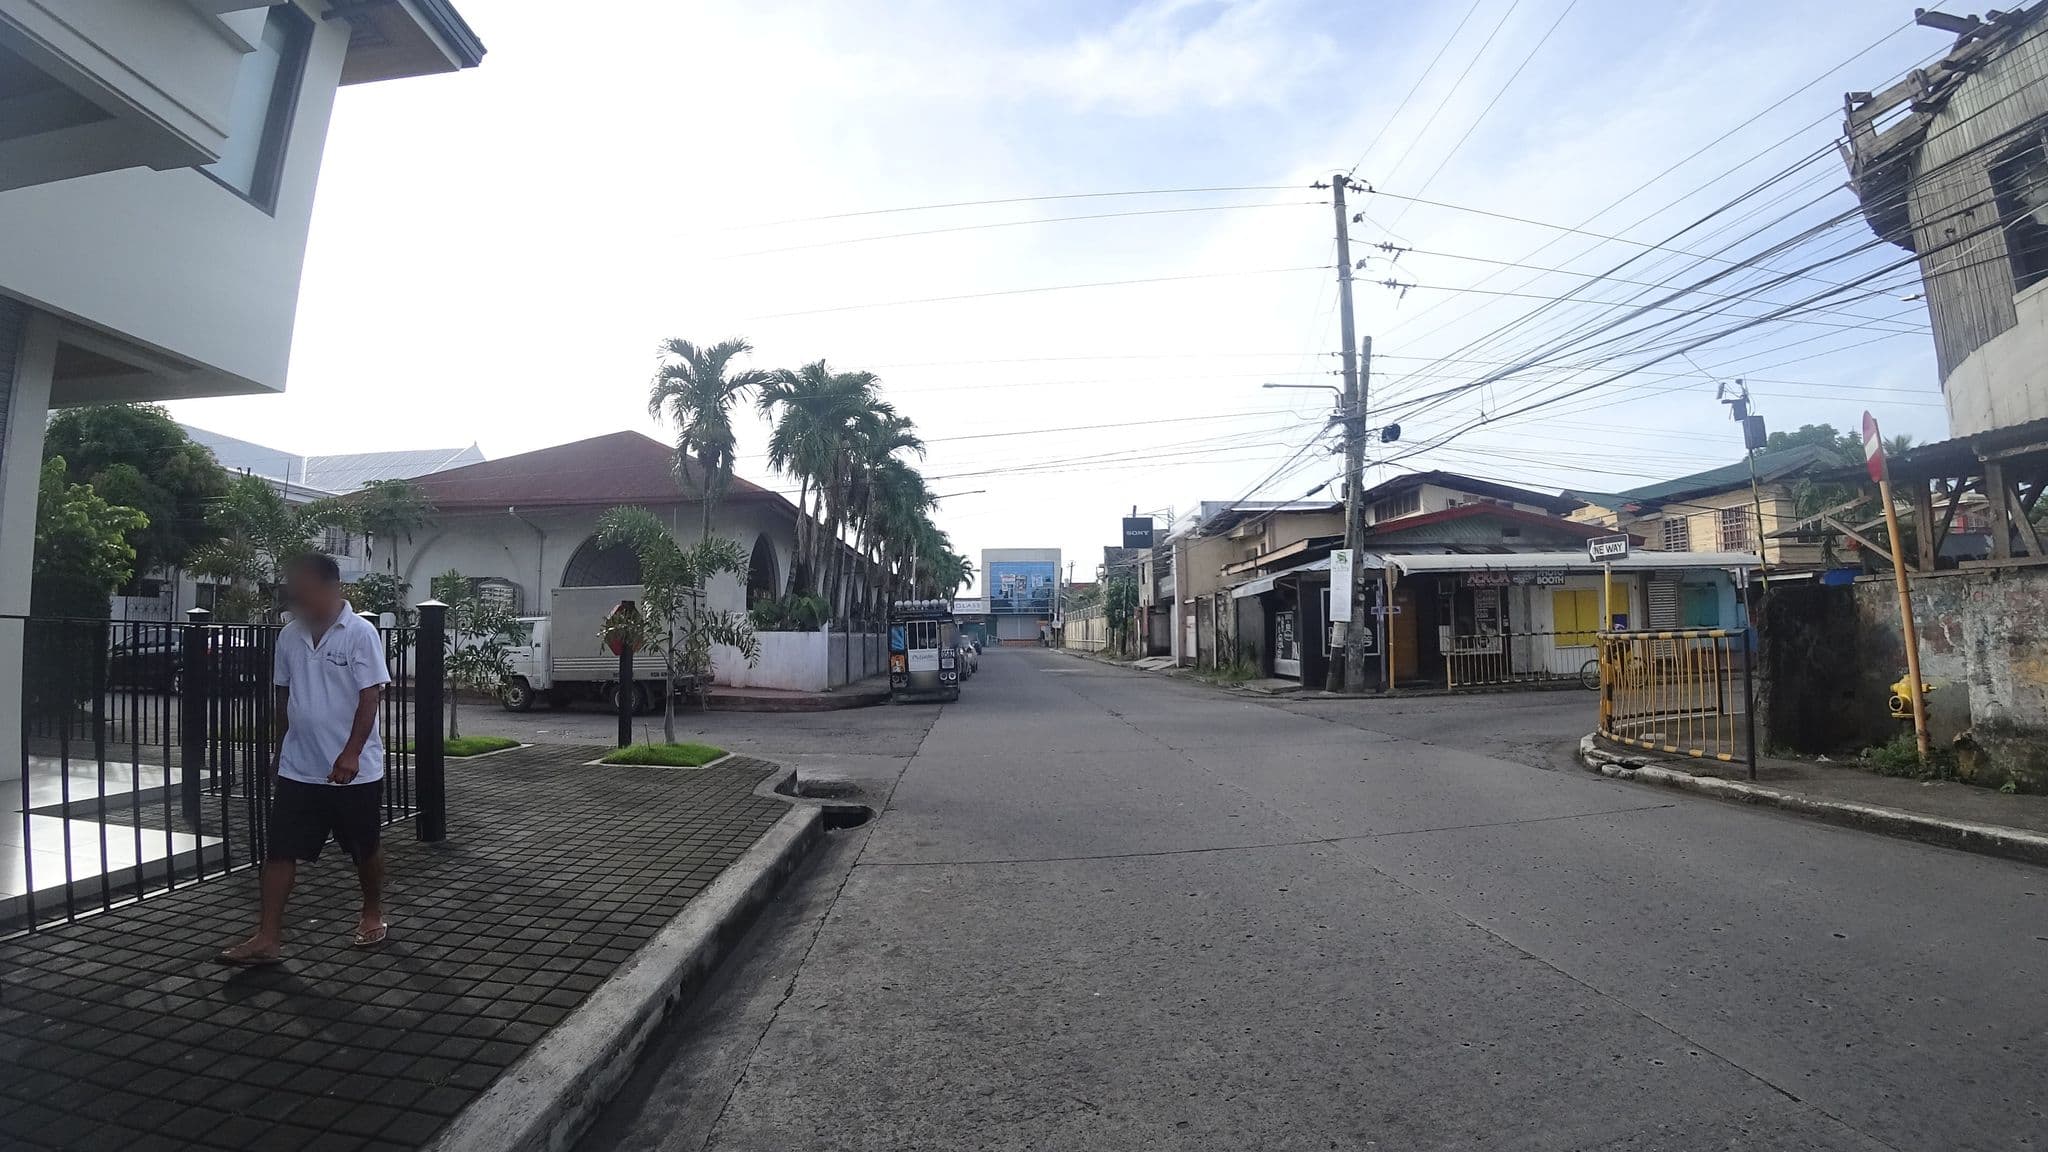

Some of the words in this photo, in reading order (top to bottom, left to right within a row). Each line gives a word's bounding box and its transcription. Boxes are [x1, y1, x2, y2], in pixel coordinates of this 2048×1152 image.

[1605, 543, 1623, 553] WAY
[1537, 569, 1564, 577] PHOTO
[1537, 577, 1564, 585] BOOTH
